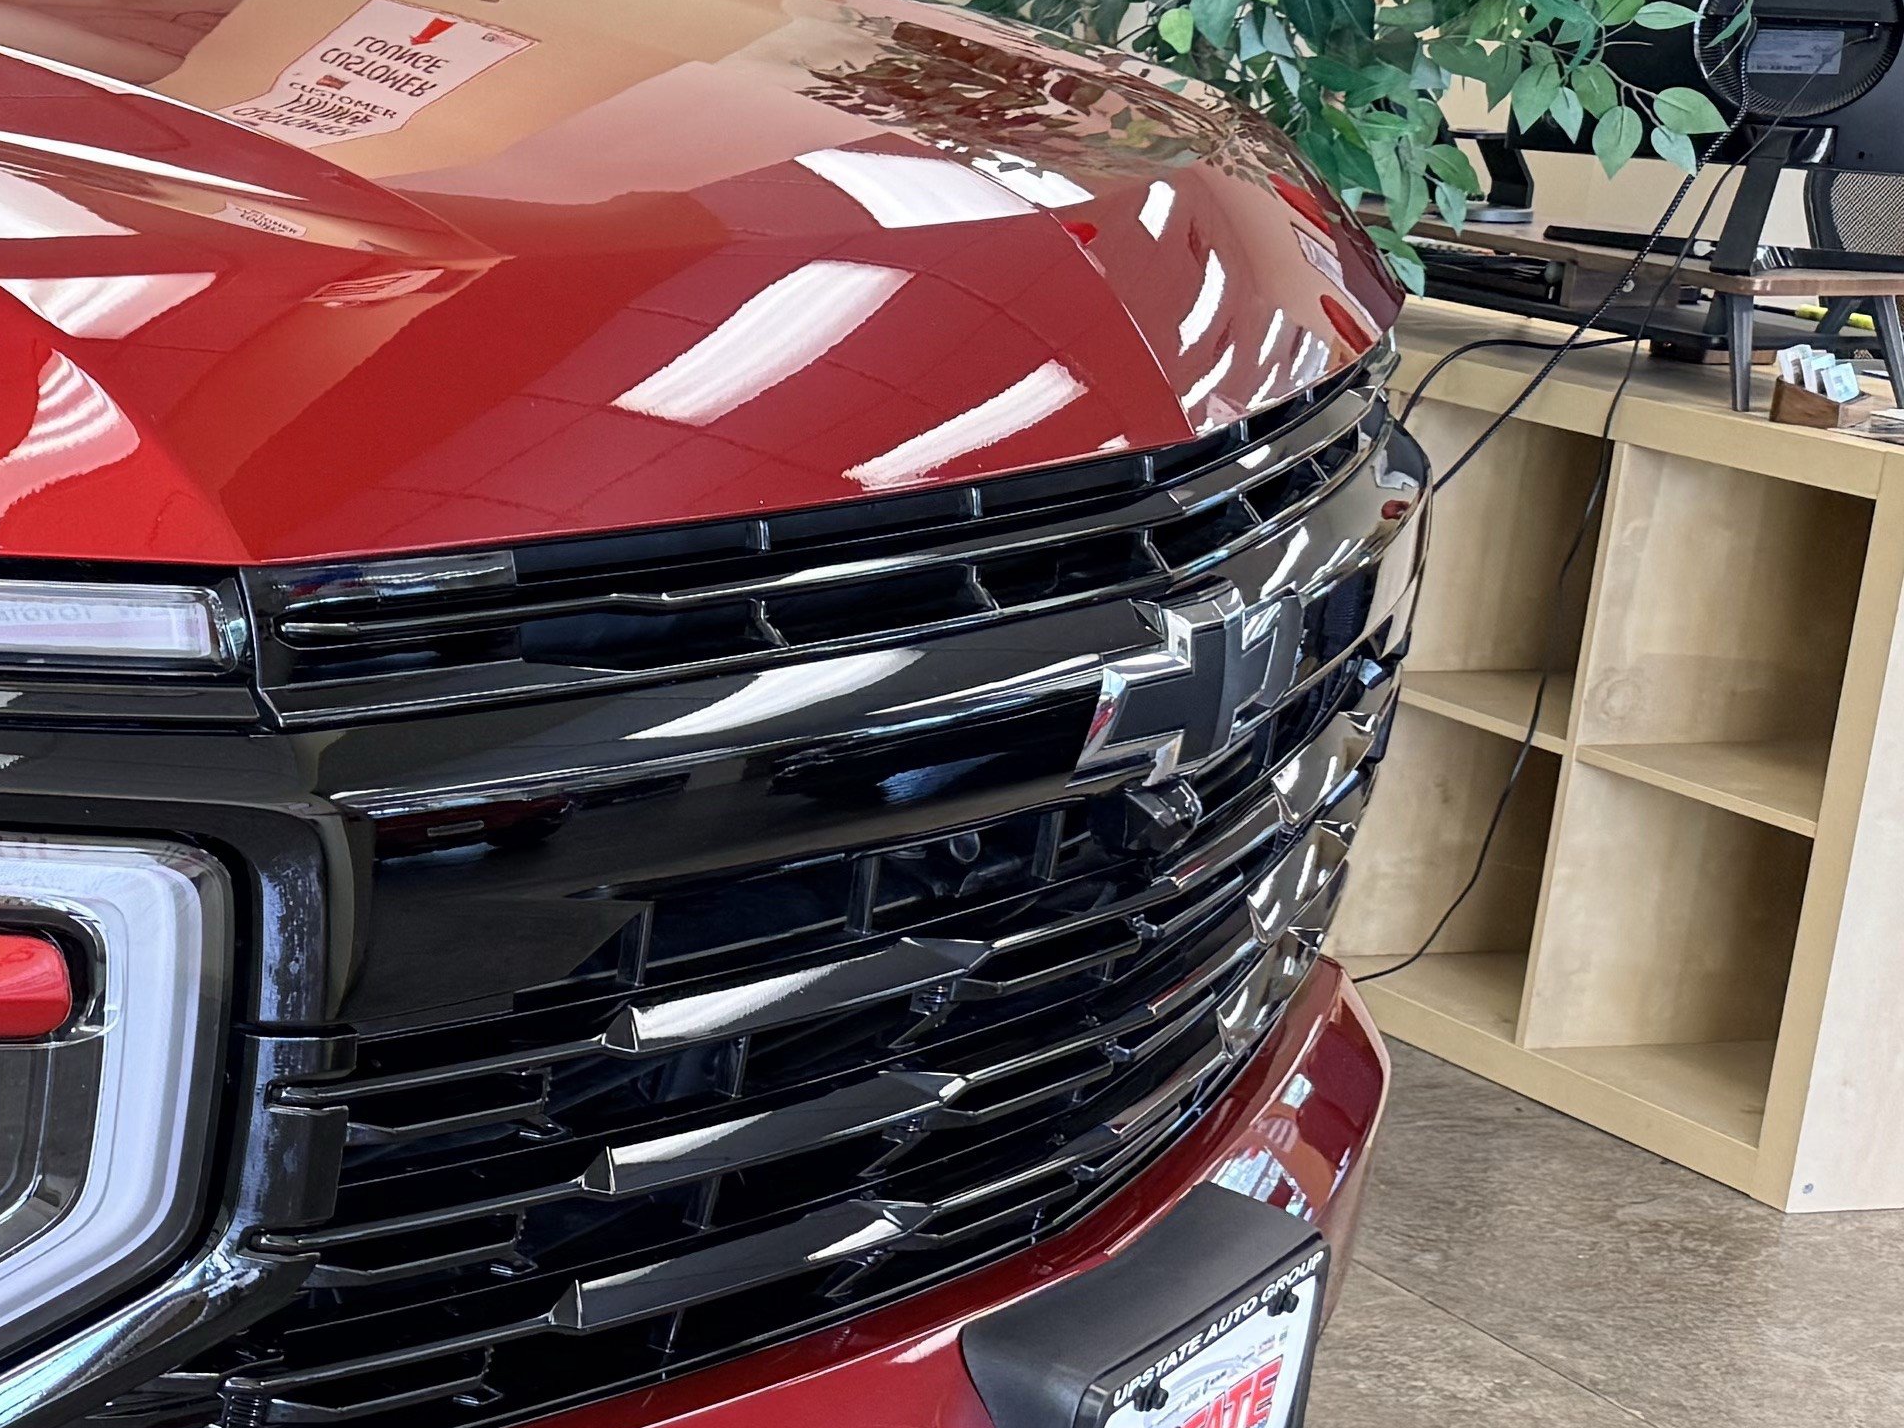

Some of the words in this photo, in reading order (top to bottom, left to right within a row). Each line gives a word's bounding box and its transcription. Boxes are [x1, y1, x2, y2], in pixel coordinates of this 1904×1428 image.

[1113, 1331, 1204, 1407] UPSTATE
[1204, 1295, 1258, 1345] AUTO
[1260, 1250, 1324, 1304] GROUP
